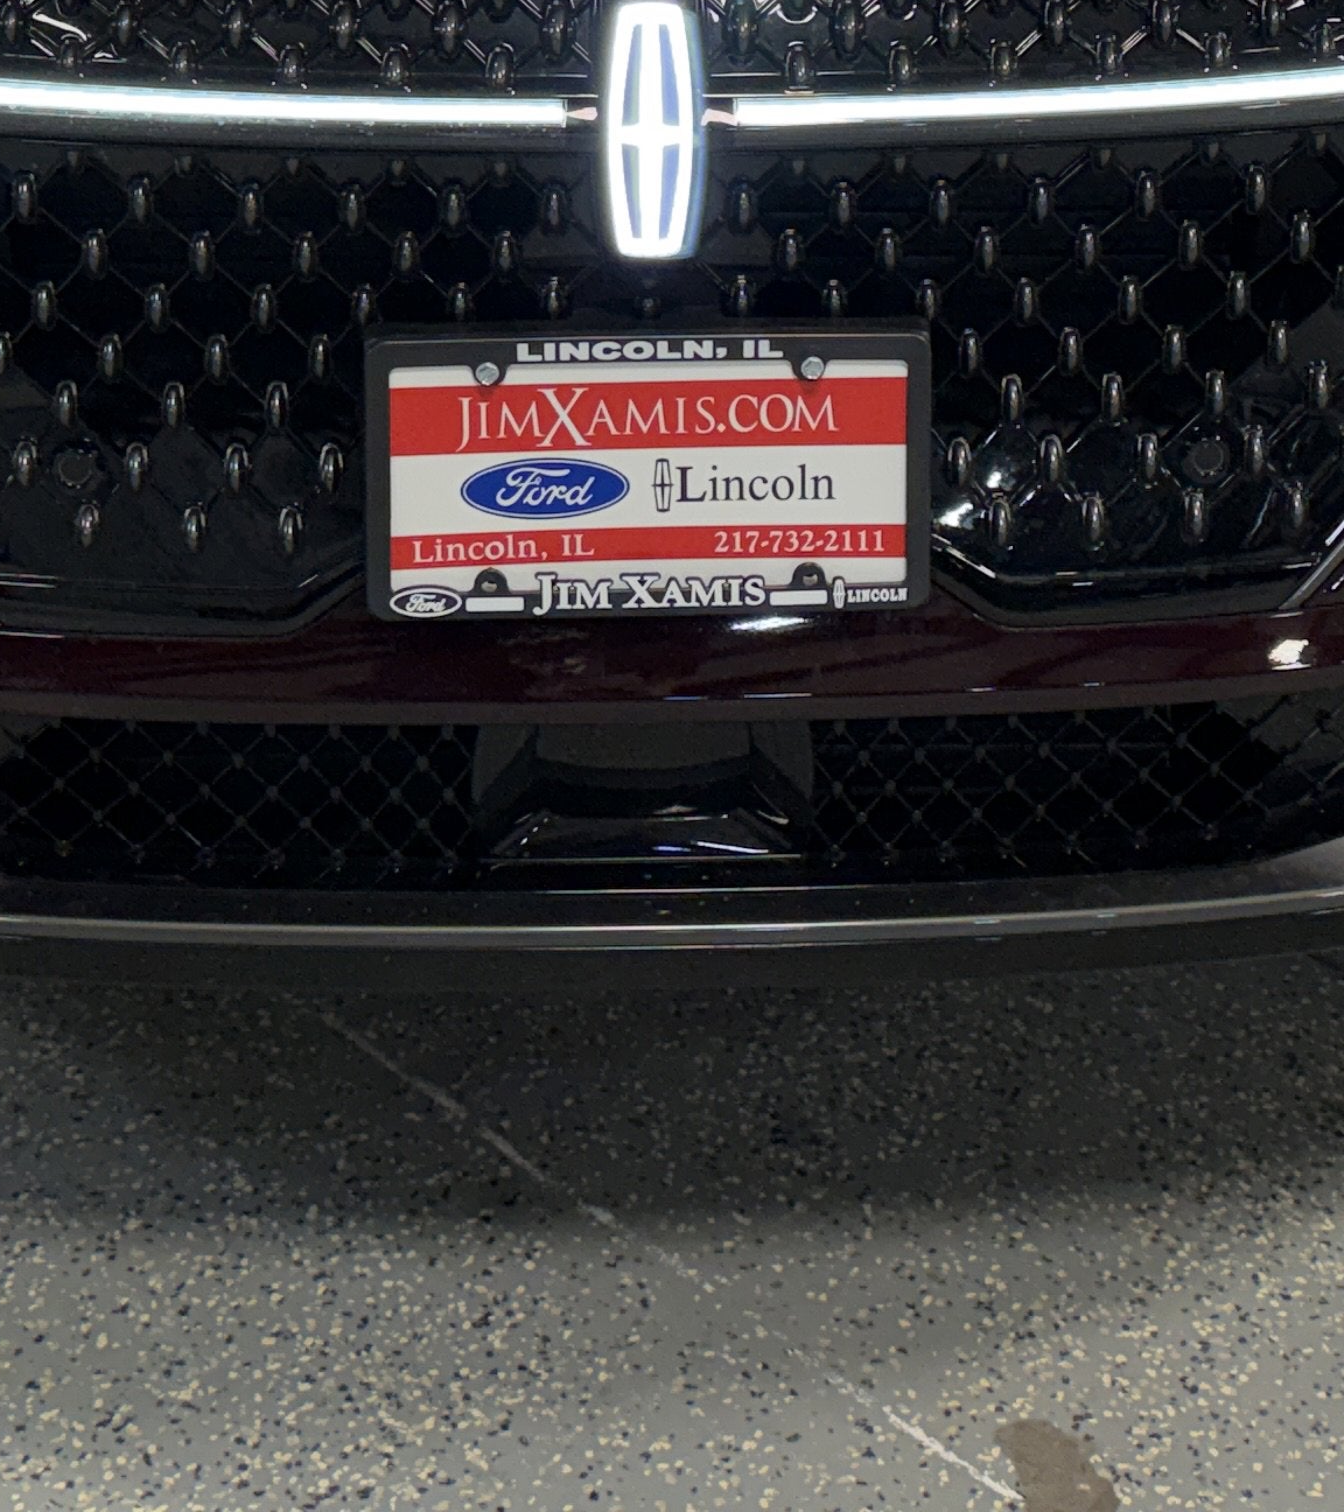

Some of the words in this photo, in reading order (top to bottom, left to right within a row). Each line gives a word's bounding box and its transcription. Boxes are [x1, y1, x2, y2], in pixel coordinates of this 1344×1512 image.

[516, 340, 728, 362] LINCOLN,
[742, 339, 784, 359] IL
[456, 387, 839, 451] JIMXAMIS.COM
[495, 468, 594, 507] Ford
[675, 463, 835, 503] Lincoln
[412, 532, 549, 563] Lincoln,
[562, 532, 595, 556] IL
[714, 529, 885, 554] 217-732-2111
[532, 573, 612, 616] JIM
[621, 574, 766, 609] XAMIS
[847, 588, 908, 603] LINCOLN
